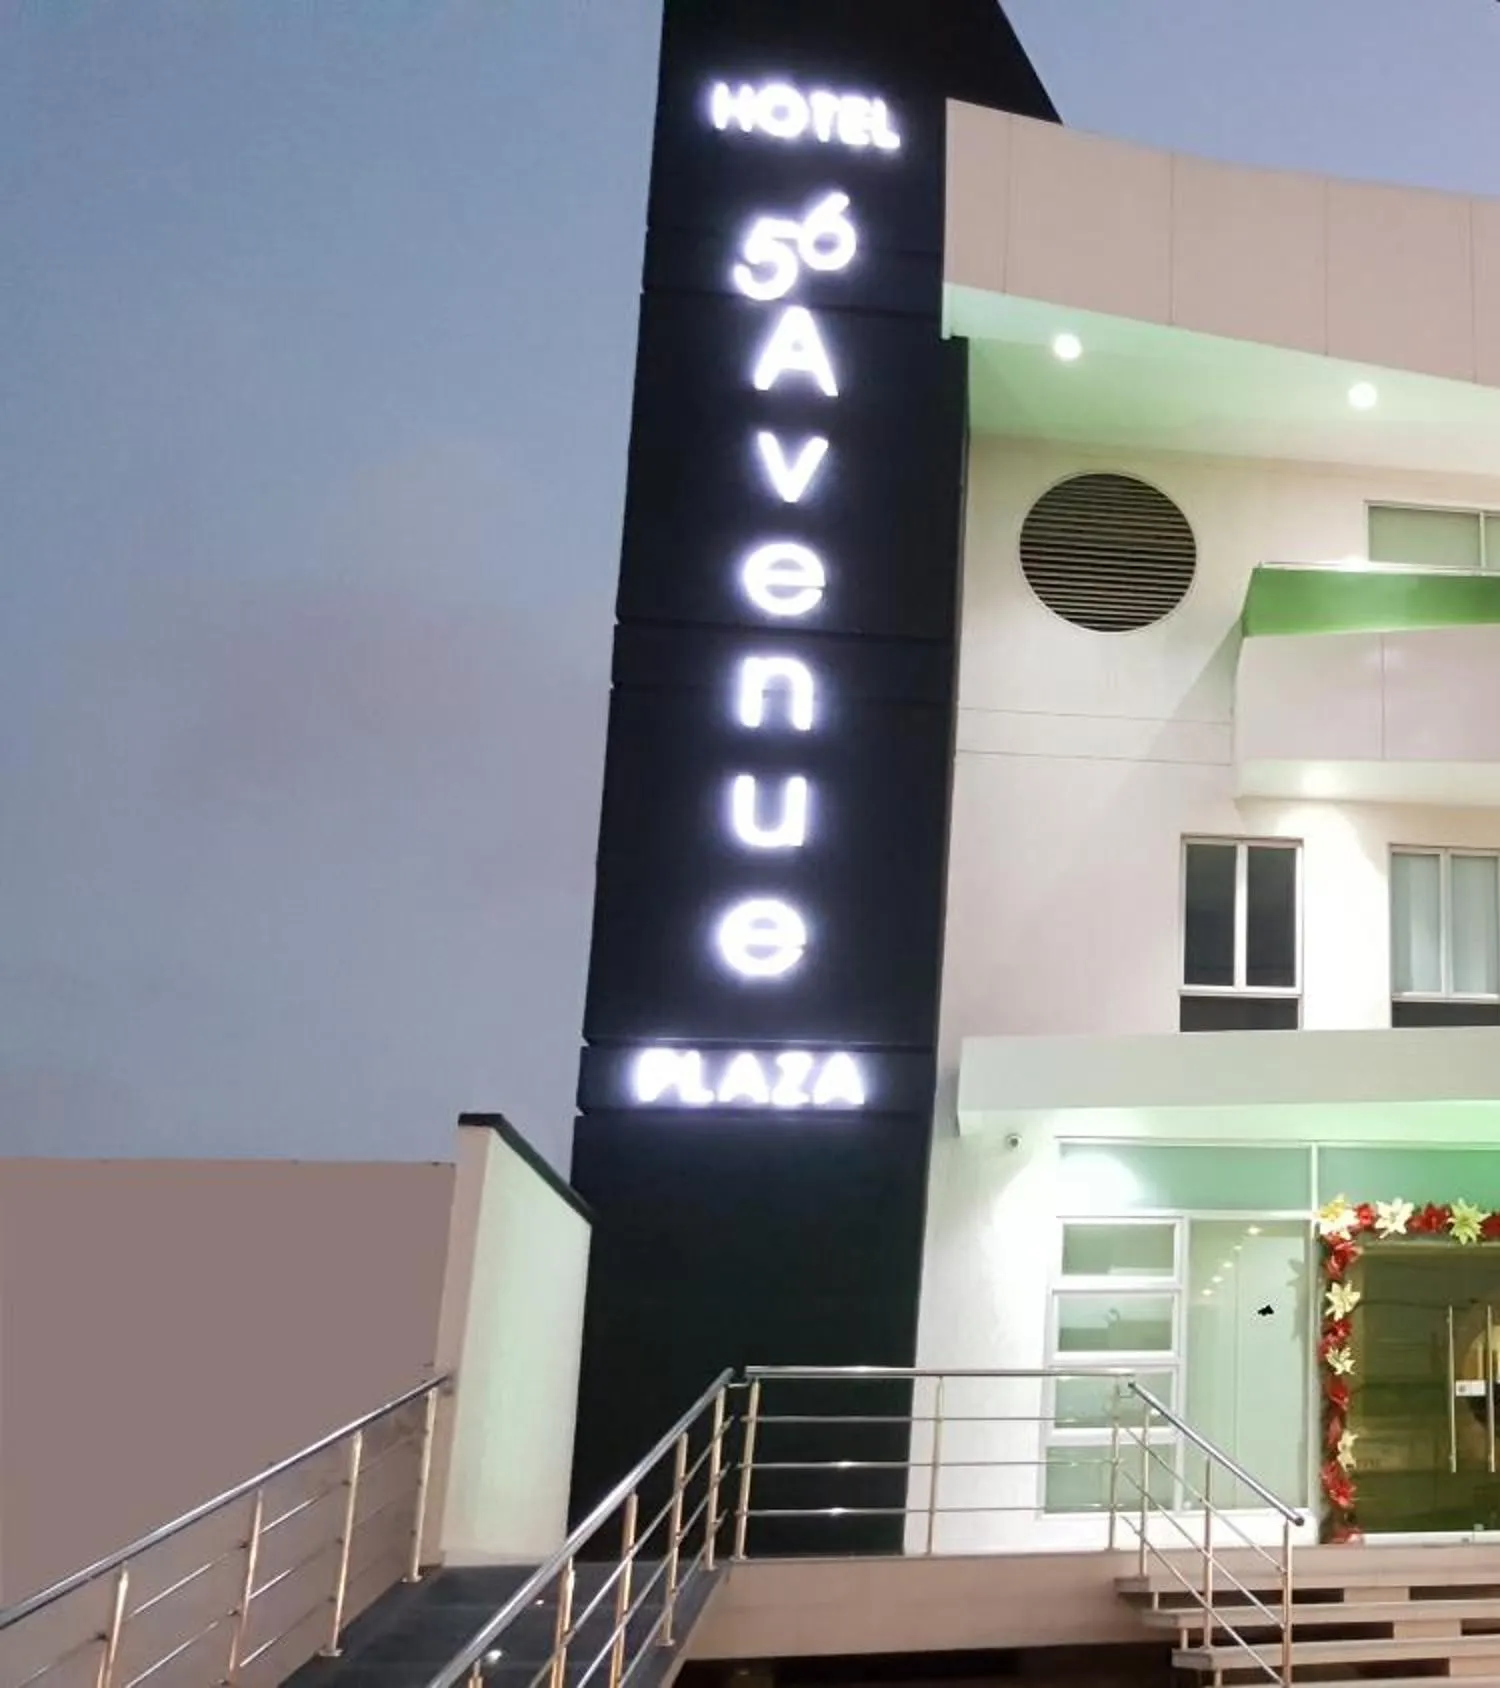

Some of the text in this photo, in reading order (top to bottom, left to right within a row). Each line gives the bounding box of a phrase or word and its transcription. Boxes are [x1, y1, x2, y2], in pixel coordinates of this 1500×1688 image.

[711, 82, 901, 149] HOTEL
[732, 192, 857, 300] 56
[632, 1048, 866, 1107] PLAZA
